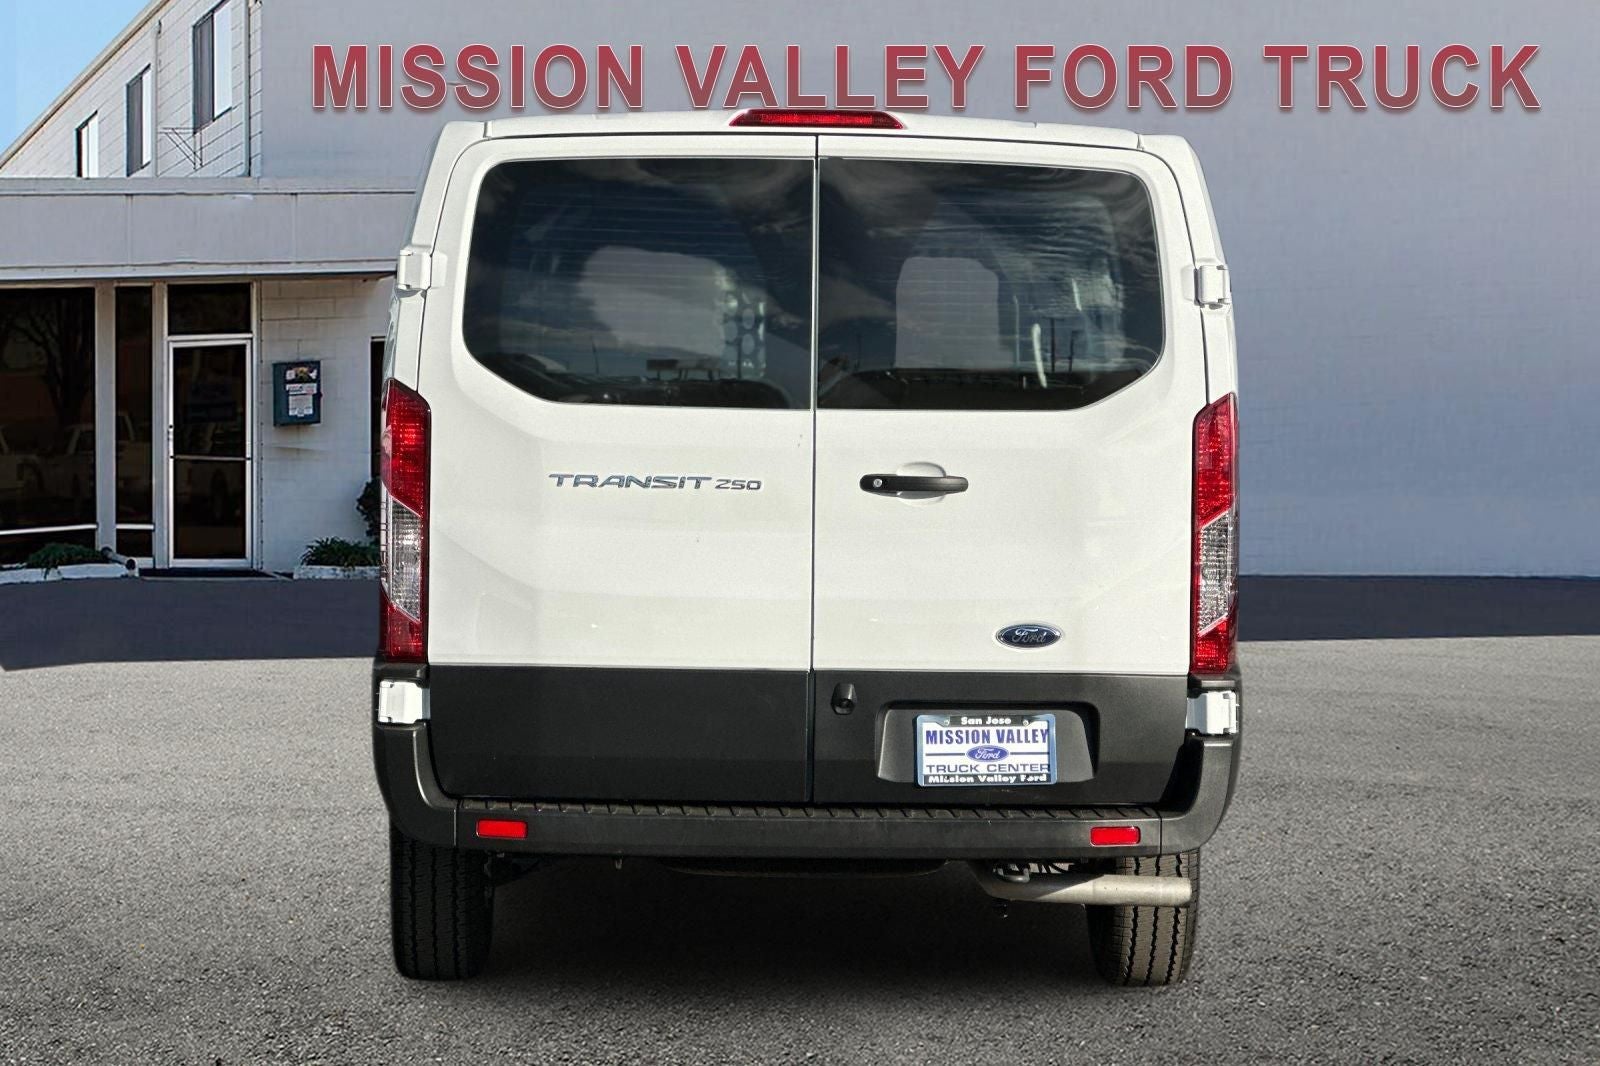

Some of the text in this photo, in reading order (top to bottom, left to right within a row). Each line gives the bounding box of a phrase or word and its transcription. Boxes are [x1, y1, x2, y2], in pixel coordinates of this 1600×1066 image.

[312, 44, 1541, 109] MISSION VALLEY FORD TRUCK
[548, 473, 762, 490] TRANSIT 250
[1012, 628, 1047, 643] Ford
[961, 716, 1012, 725] San Jose
[926, 728, 1049, 745] MISSION VALLEY
[974, 748, 1001, 760] Ford
[926, 763, 1050, 773] TRUCK CENTER
[928, 774, 1047, 783] Mission Valley Ford
